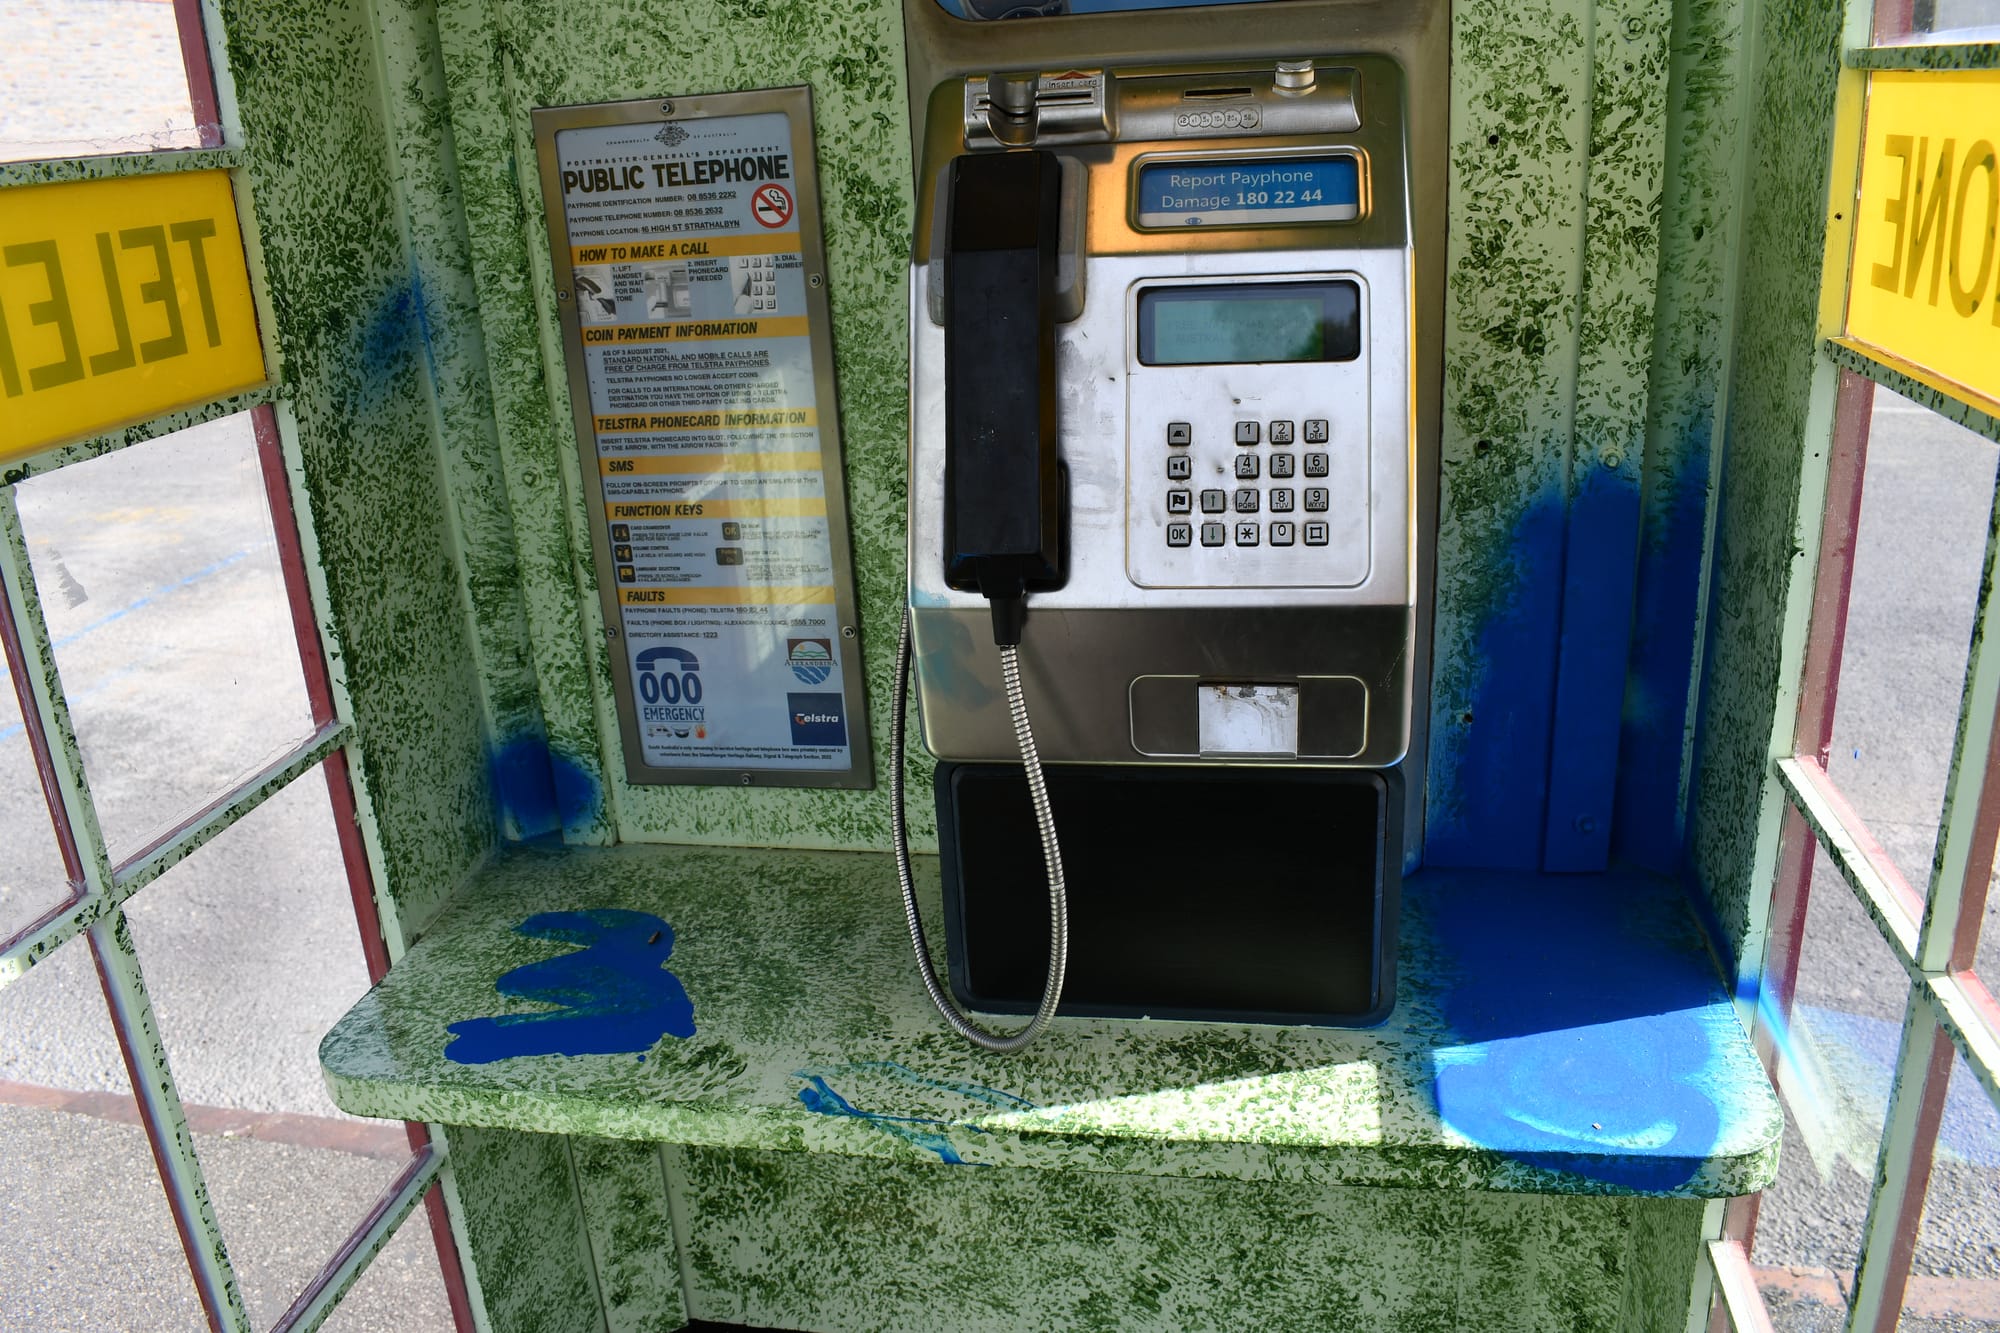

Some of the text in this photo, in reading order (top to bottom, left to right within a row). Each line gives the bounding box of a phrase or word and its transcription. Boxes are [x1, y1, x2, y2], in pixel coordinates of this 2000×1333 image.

[567, 146, 780, 167] POSTMASTER-GENERAL'S DEPARTMENT
[562, 154, 790, 194] PUBLIC TELEPHONE
[1170, 170, 1313, 190] Report Payphone
[602, 198, 652, 207] IDENTIFICATION
[718, 191, 737, 200] 22X2
[1162, 189, 1322, 210] Damage 180 22 44
[569, 216, 602, 224] PAYPHONE
[674, 209, 683, 217] 08
[571, 230, 605, 238] PAYPHONE
[606, 228, 640, 236] LOCATION:
[651, 224, 671, 232] HIGH
[672, 224, 682, 232] ST
[684, 220, 740, 230] STRATHALBYN
[580, 242, 710, 262] HOW TO MAKE A CALL
[612, 272, 642, 280] HANDSET
[688, 267, 728, 275] PHONECARD
[614, 280, 628, 288] AND
[696, 274, 723, 282] NEEDED
[586, 322, 758, 341] COIN PAYMENT INFORMATION
[603, 356, 642, 364] STANDARD
[643, 354, 680, 362] NATIONAL
[698, 352, 726, 360] MOBILE
[754, 350, 769, 358] ARE
[668, 362, 689, 370] FROM
[725, 359, 770, 368] PAYPHONES
[663, 384, 712, 392] INTERNATIONAL
[598, 412, 806, 430] TELSTRA PHONECARD INFORMATION
[1244, 424, 1250, 434] 1
[1278, 423, 1286, 434] 2
[1312, 422, 1320, 434] 3
[692, 434, 706, 442] INTO
[608, 460, 634, 472] SMS
[1242, 456, 1251, 468] 4
[1278, 456, 1286, 468] 5
[1312, 456, 1320, 467] 6
[1244, 492, 1251, 503] 7
[1278, 490, 1286, 502] 8
[1312, 490, 1320, 502] 9
[615, 504, 704, 516] FUNCTION KEYS
[1172, 528, 1186, 540] OK
[1278, 524, 1286, 536] 0
[626, 591, 665, 602] FAULTS
[640, 672, 702, 704] 000
[644, 708, 705, 720] EMERGENCY
[795, 714, 839, 725] Telstra
